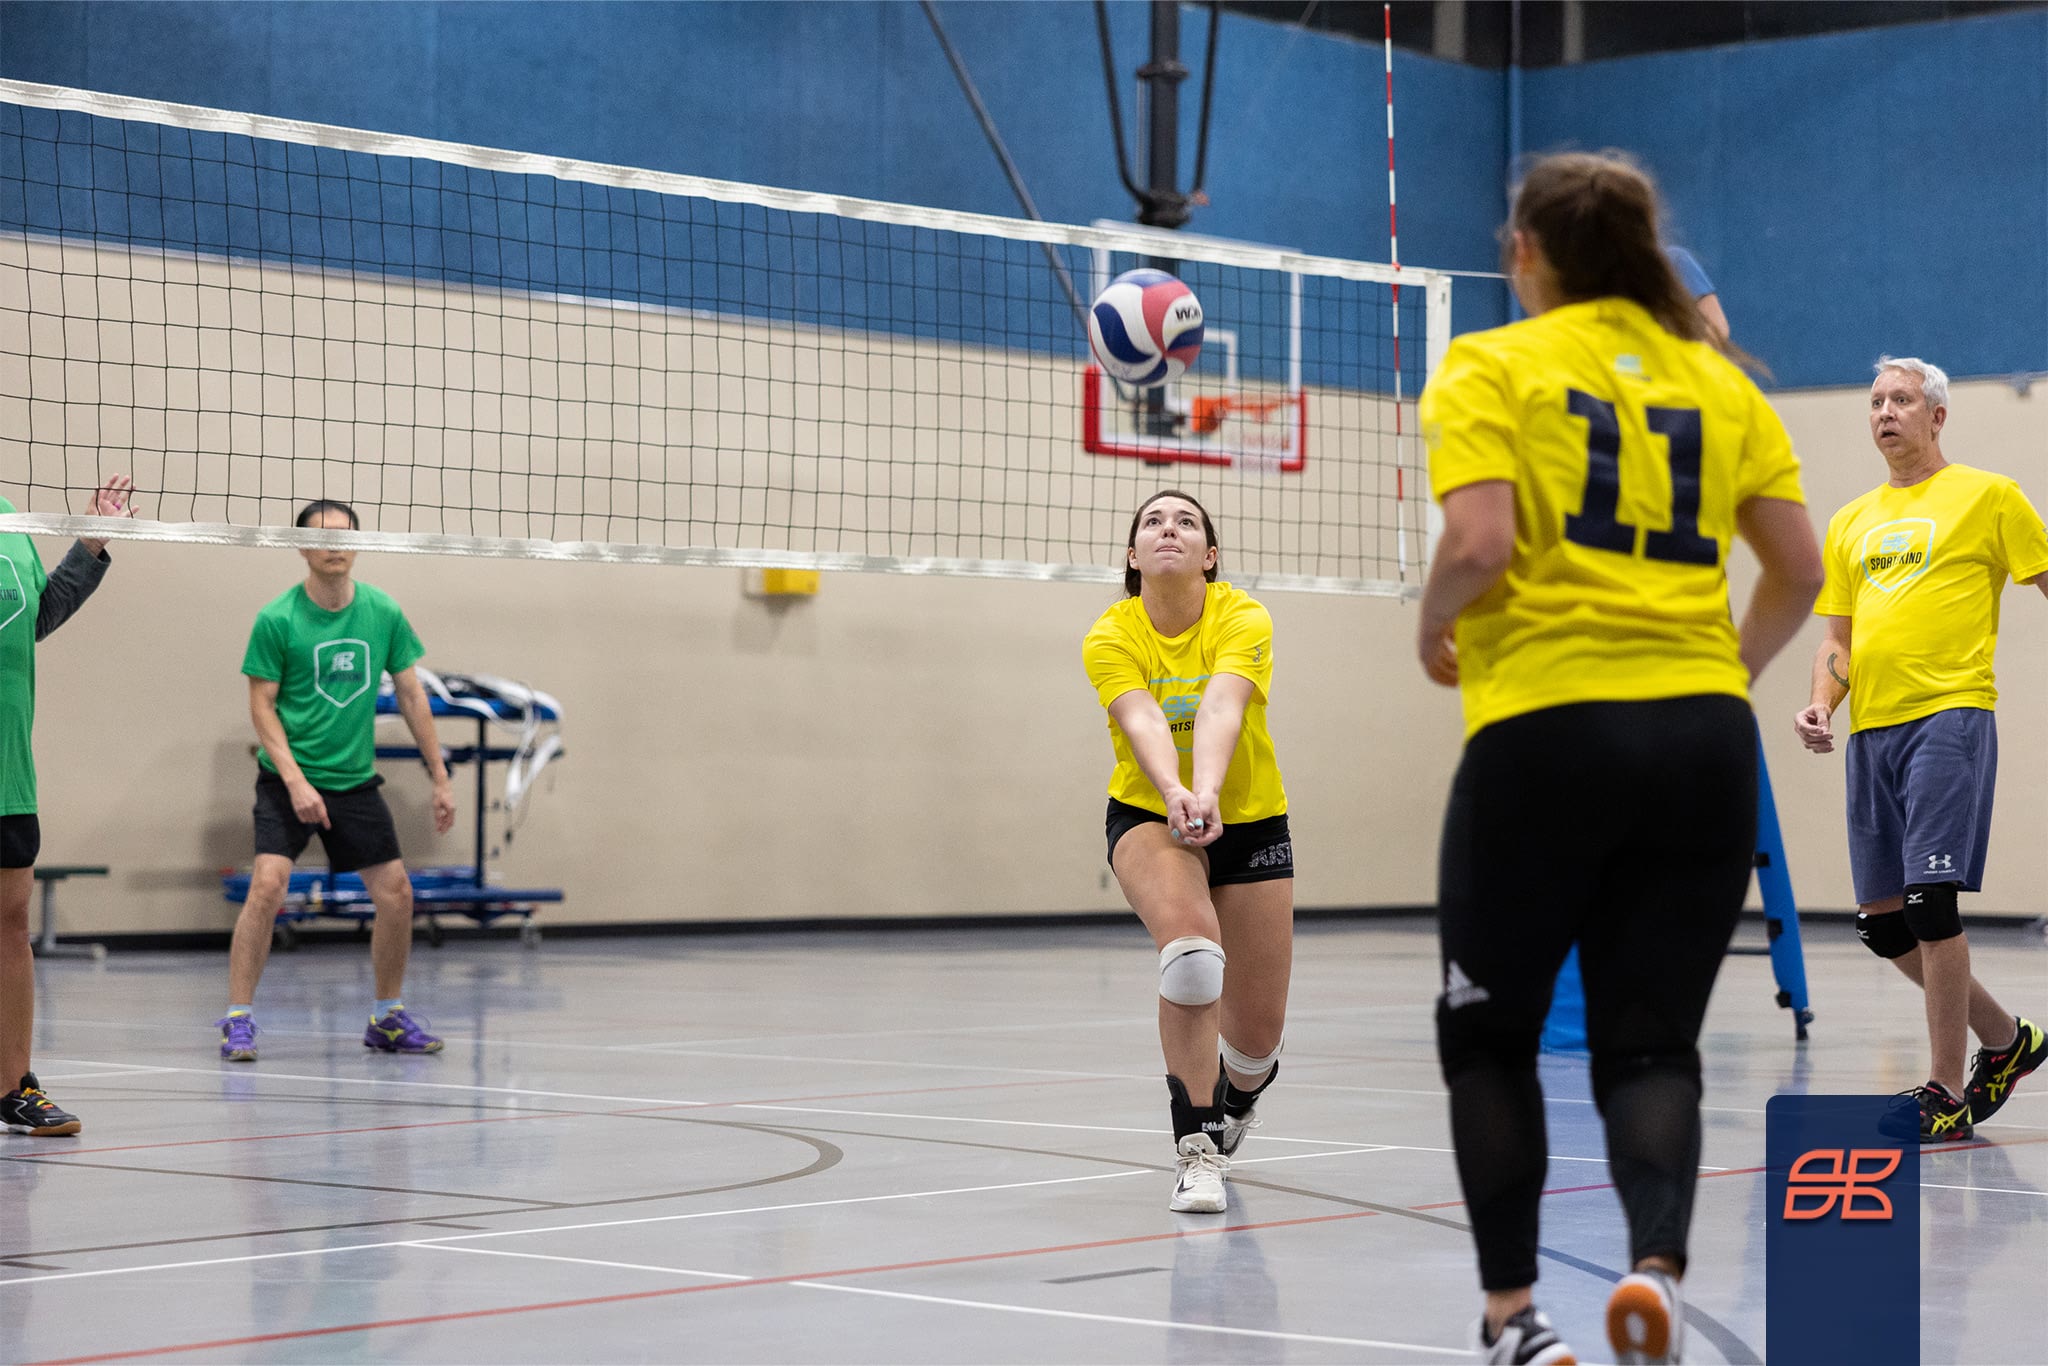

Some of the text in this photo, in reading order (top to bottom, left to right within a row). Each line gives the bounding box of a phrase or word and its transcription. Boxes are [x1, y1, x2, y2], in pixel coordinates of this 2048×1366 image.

[1565, 387, 1719, 567] 11
[1870, 551, 1922, 571] SPORTKIND
[1170, 719, 1195, 733] RTS
